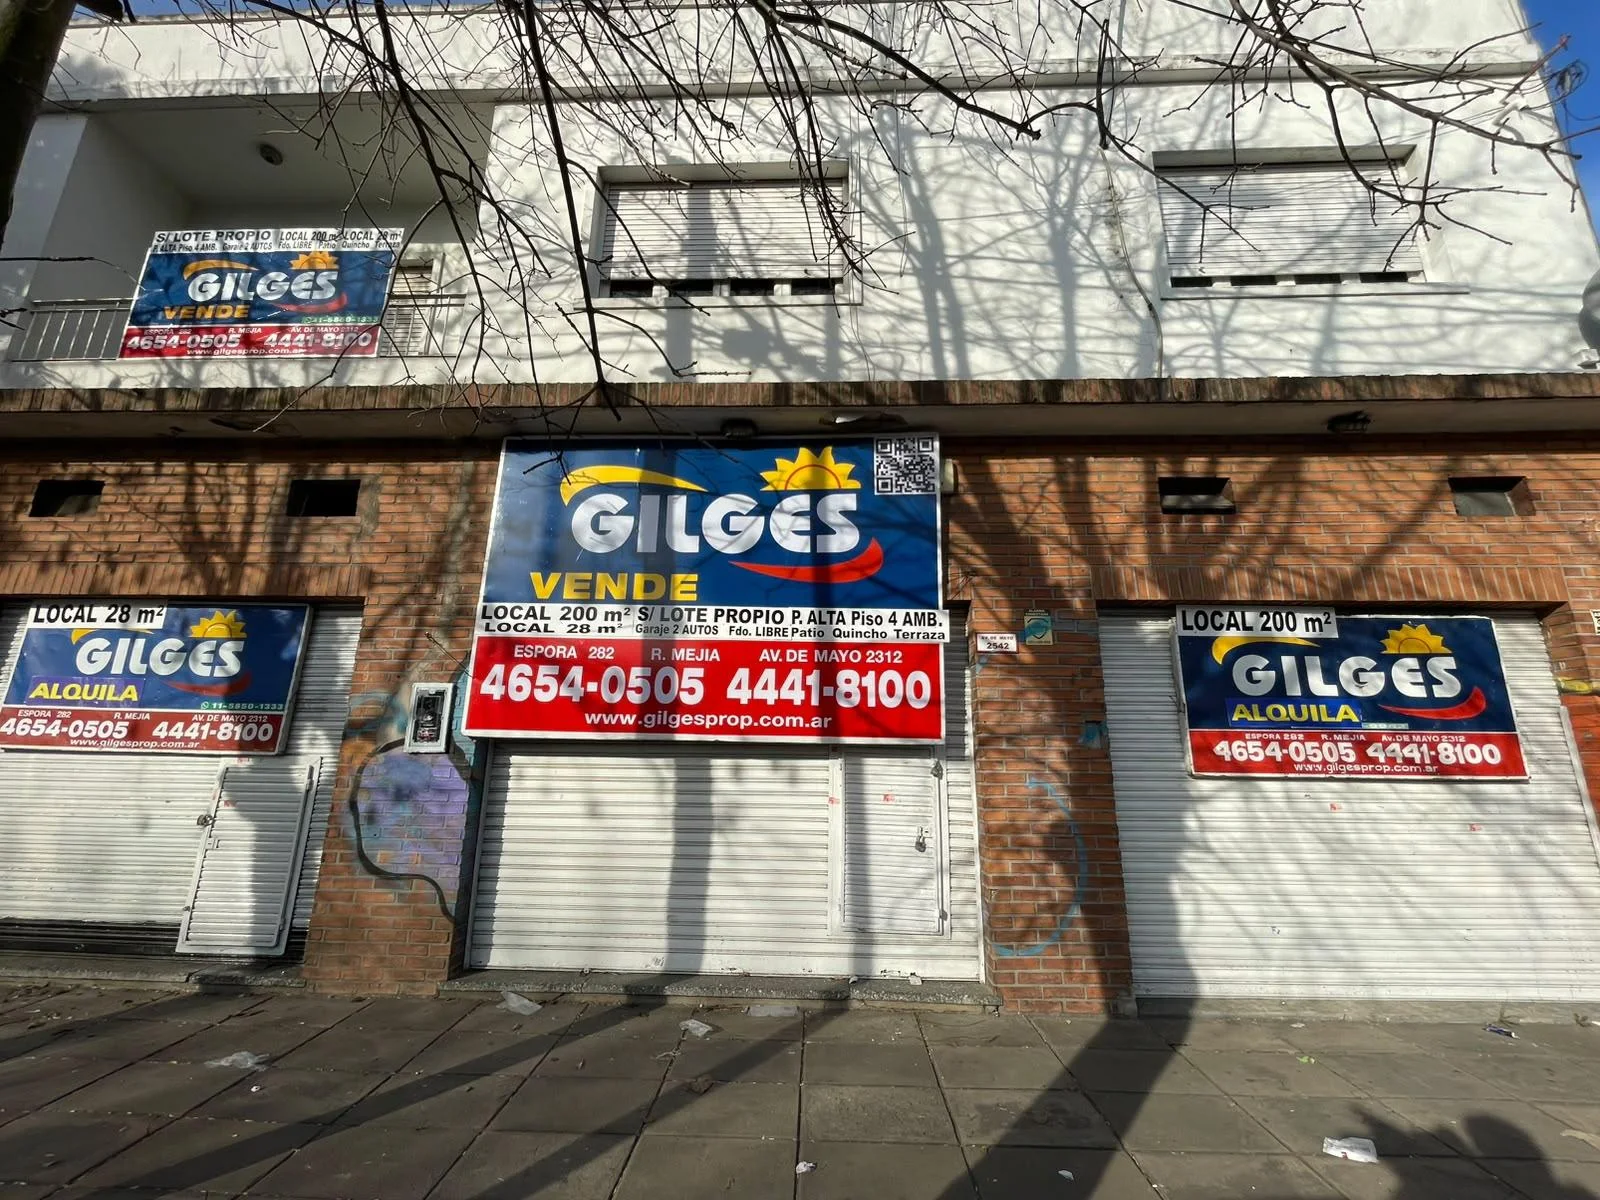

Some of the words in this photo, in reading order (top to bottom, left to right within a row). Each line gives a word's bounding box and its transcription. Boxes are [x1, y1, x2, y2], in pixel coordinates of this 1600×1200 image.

[157, 233, 169, 243] S/
[174, 232, 211, 242] LOTE
[215, 230, 272, 240] PROPIO
[280, 232, 308, 240] LOCAL
[311, 231, 326, 240] 200
[344, 231, 374, 240] LOCAL
[160, 244, 177, 252] ALTA
[178, 244, 193, 252] Piso
[194, 244, 199, 252] 4
[319, 241, 336, 249] Patio
[342, 241, 370, 249] Quincho
[187, 271, 340, 301] GILGES
[164, 304, 250, 320] VENDE
[126, 334, 241, 350] 4654-0505
[264, 332, 372, 347] 4441-8100
[572, 493, 860, 554] GILGES
[530, 572, 698, 602] VENDE
[33, 604, 98, 624] LOCAL
[106, 604, 130, 623] 28
[136, 605, 164, 624] m²
[481, 605, 551, 620] LOCAL
[560, 606, 598, 621] 200
[604, 607, 630, 622] m²
[638, 607, 654, 622] S/
[660, 608, 706, 622] LOTE
[714, 609, 784, 625] PROPIO
[792, 610, 802, 625] P.
[807, 610, 846, 626] ALTA
[851, 611, 883, 626] Piso
[888, 612, 897, 626] 4
[903, 612, 943, 627] AMB.
[484, 623, 555, 633] LOCAL
[566, 624, 590, 633] 28
[598, 623, 623, 634] m²
[1181, 610, 1254, 632] LOCAL
[1260, 611, 1297, 633] 200
[1304, 612, 1332, 634] m²
[636, 624, 670, 636] Garaje
[673, 624, 679, 634] 2
[682, 625, 719, 635] AUTOS
[729, 626, 751, 636] Fdo.
[756, 627, 789, 637] LIBRE
[791, 627, 824, 638] Patio
[833, 628, 887, 639] Quincho
[894, 629, 945, 640] Terraza
[76, 638, 245, 678] GILGES
[514, 645, 578, 660] ESPORA
[588, 646, 614, 660] 282
[651, 648, 667, 662] R.
[671, 647, 720, 662] MEJIA
[759, 649, 783, 663] AV.
[785, 649, 809, 663] DE
[813, 649, 862, 664] MAYO
[865, 650, 903, 664] 2312
[480, 664, 704, 704] 4654-0505
[1232, 654, 1461, 698] GILGES
[29, 683, 139, 702] ALQUILA
[726, 667, 932, 709] 4441-8100
[18, 709, 52, 718] ESPORA
[125, 712, 150, 720] MEJIA
[192, 714, 205, 722] AV.
[1232, 704, 1360, 722] ALQUILA
[0, 718, 129, 739] 4654-0505
[584, 712, 832, 732] www.gilgesprop.com.ar
[152, 721, 273, 742] 4441-8100
[1333, 734, 1366, 742] MEJIA
[70, 739, 200, 749] www.gilgesprop.com.ar
[1212, 740, 1356, 763] 4654-0505
[1366, 742, 1500, 765] 4441-8100
[1294, 763, 1438, 774] www.gilgesprop.com.ar
